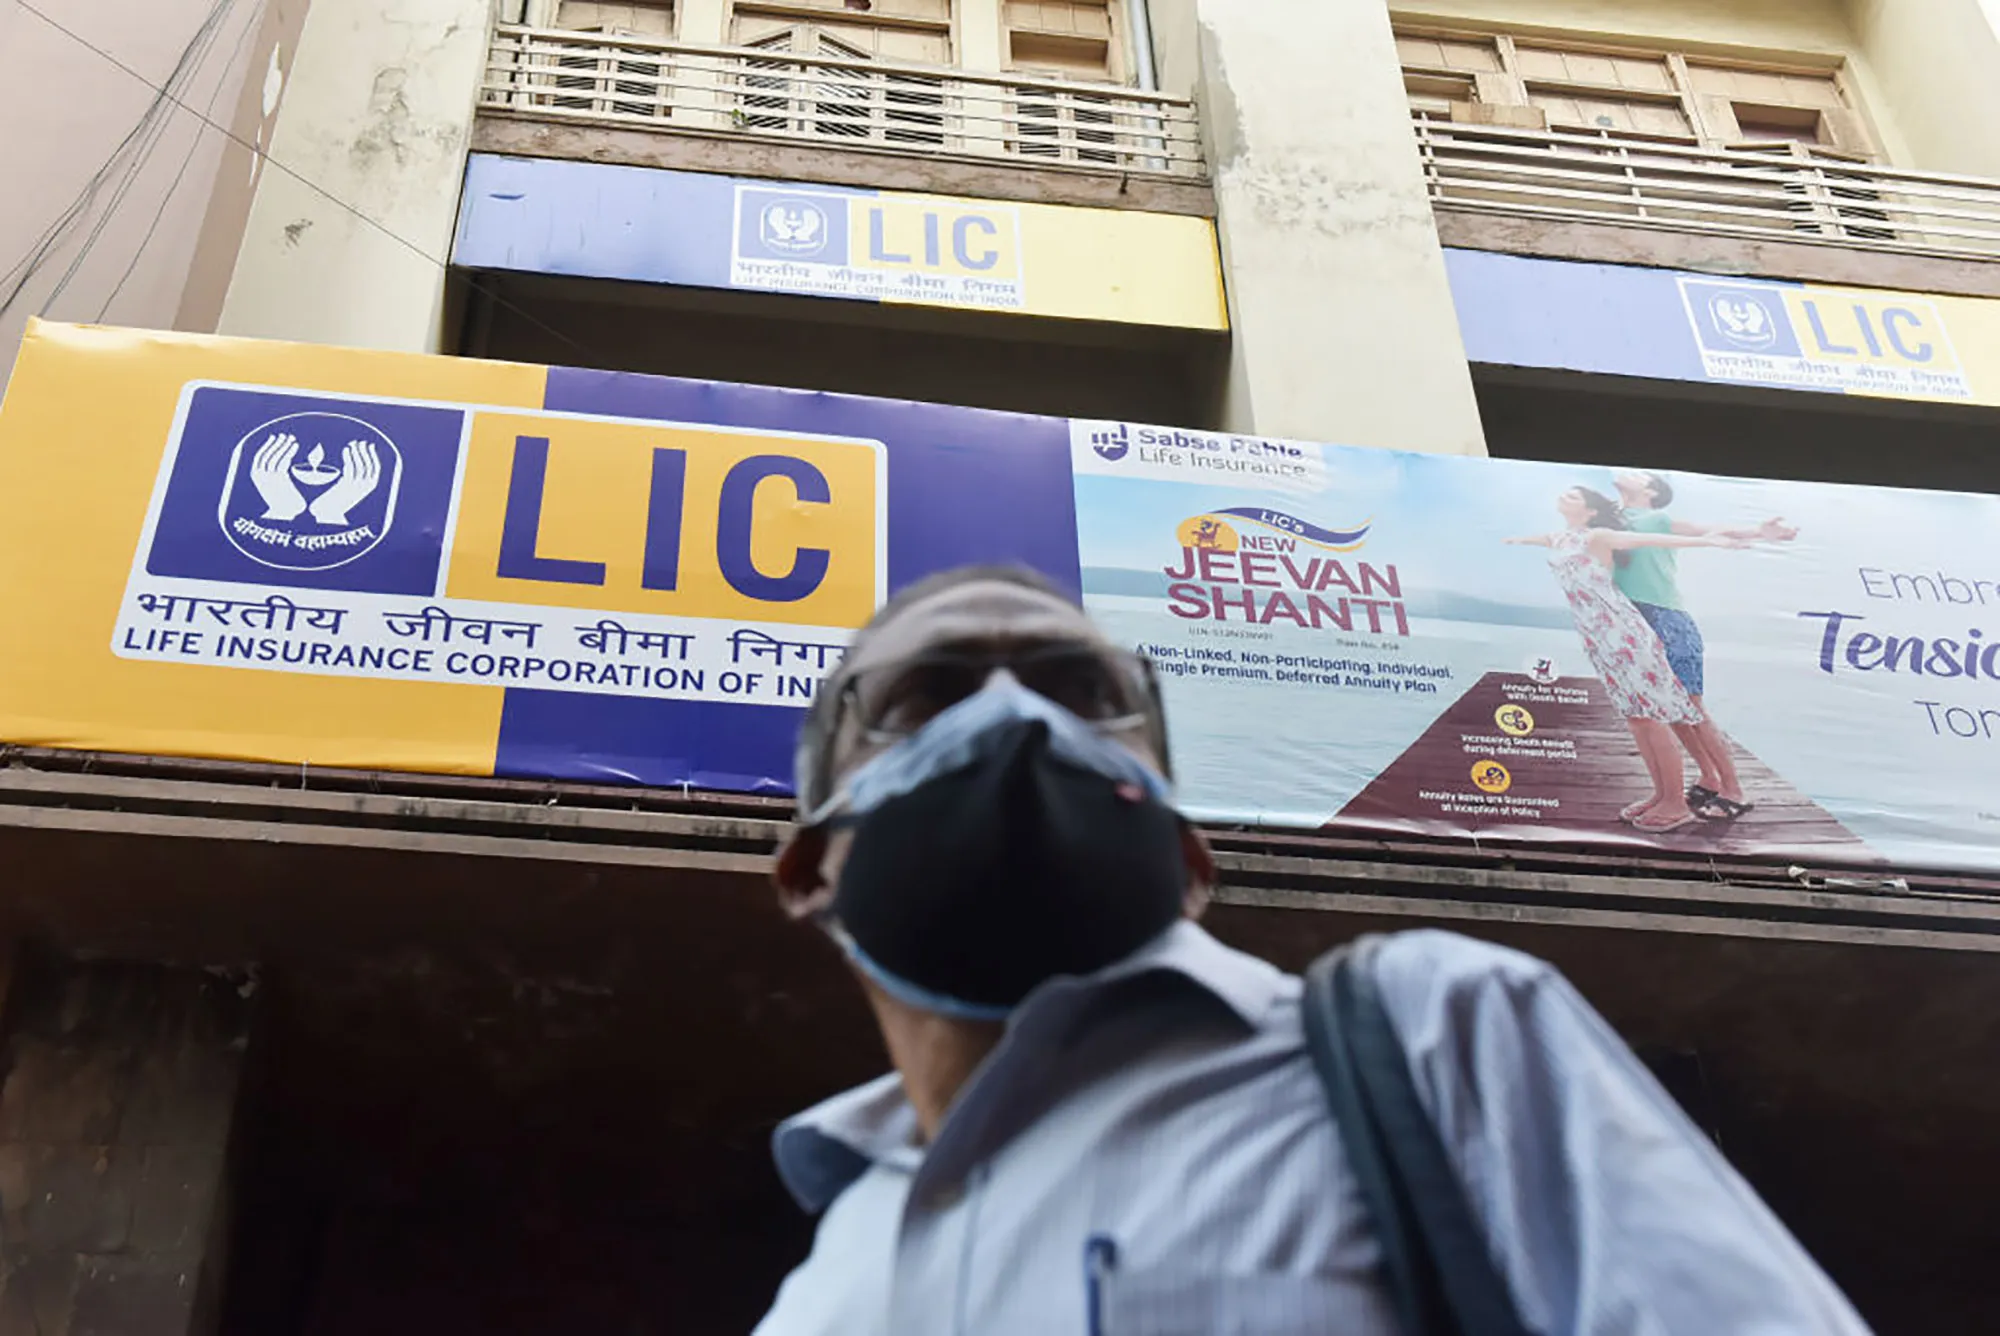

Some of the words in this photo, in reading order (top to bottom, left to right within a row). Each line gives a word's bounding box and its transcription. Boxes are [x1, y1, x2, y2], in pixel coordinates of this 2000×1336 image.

[869, 208, 998, 270] LIC
[1800, 300, 1933, 362] LIC
[1138, 428, 1220, 452] Sabse
[1140, 446, 1182, 467] Life
[1190, 452, 1306, 477] Insurance
[497, 435, 831, 602] LIC
[1260, 510, 1305, 534] LIC's
[1241, 535, 1296, 552] NEW
[1164, 546, 1402, 598] JEEVAN
[1859, 567, 2000, 604] Embr
[137, 593, 349, 635] भारतीय
[383, 606, 542, 649] जीवन
[575, 619, 695, 661] बीमा
[1167, 583, 1410, 637] SHANTI
[124, 627, 203, 655] LIFE
[216, 635, 433, 672] INSURANCE
[446, 651, 704, 691] CORPORATION
[719, 671, 763, 696] OF
[1149, 644, 1236, 664] Non-Linked,
[1377, 662, 1454, 679] Individual,
[1276, 670, 1340, 686] Deferred
[1345, 672, 1402, 693] Annuity
[1405, 679, 1437, 694] Plan
